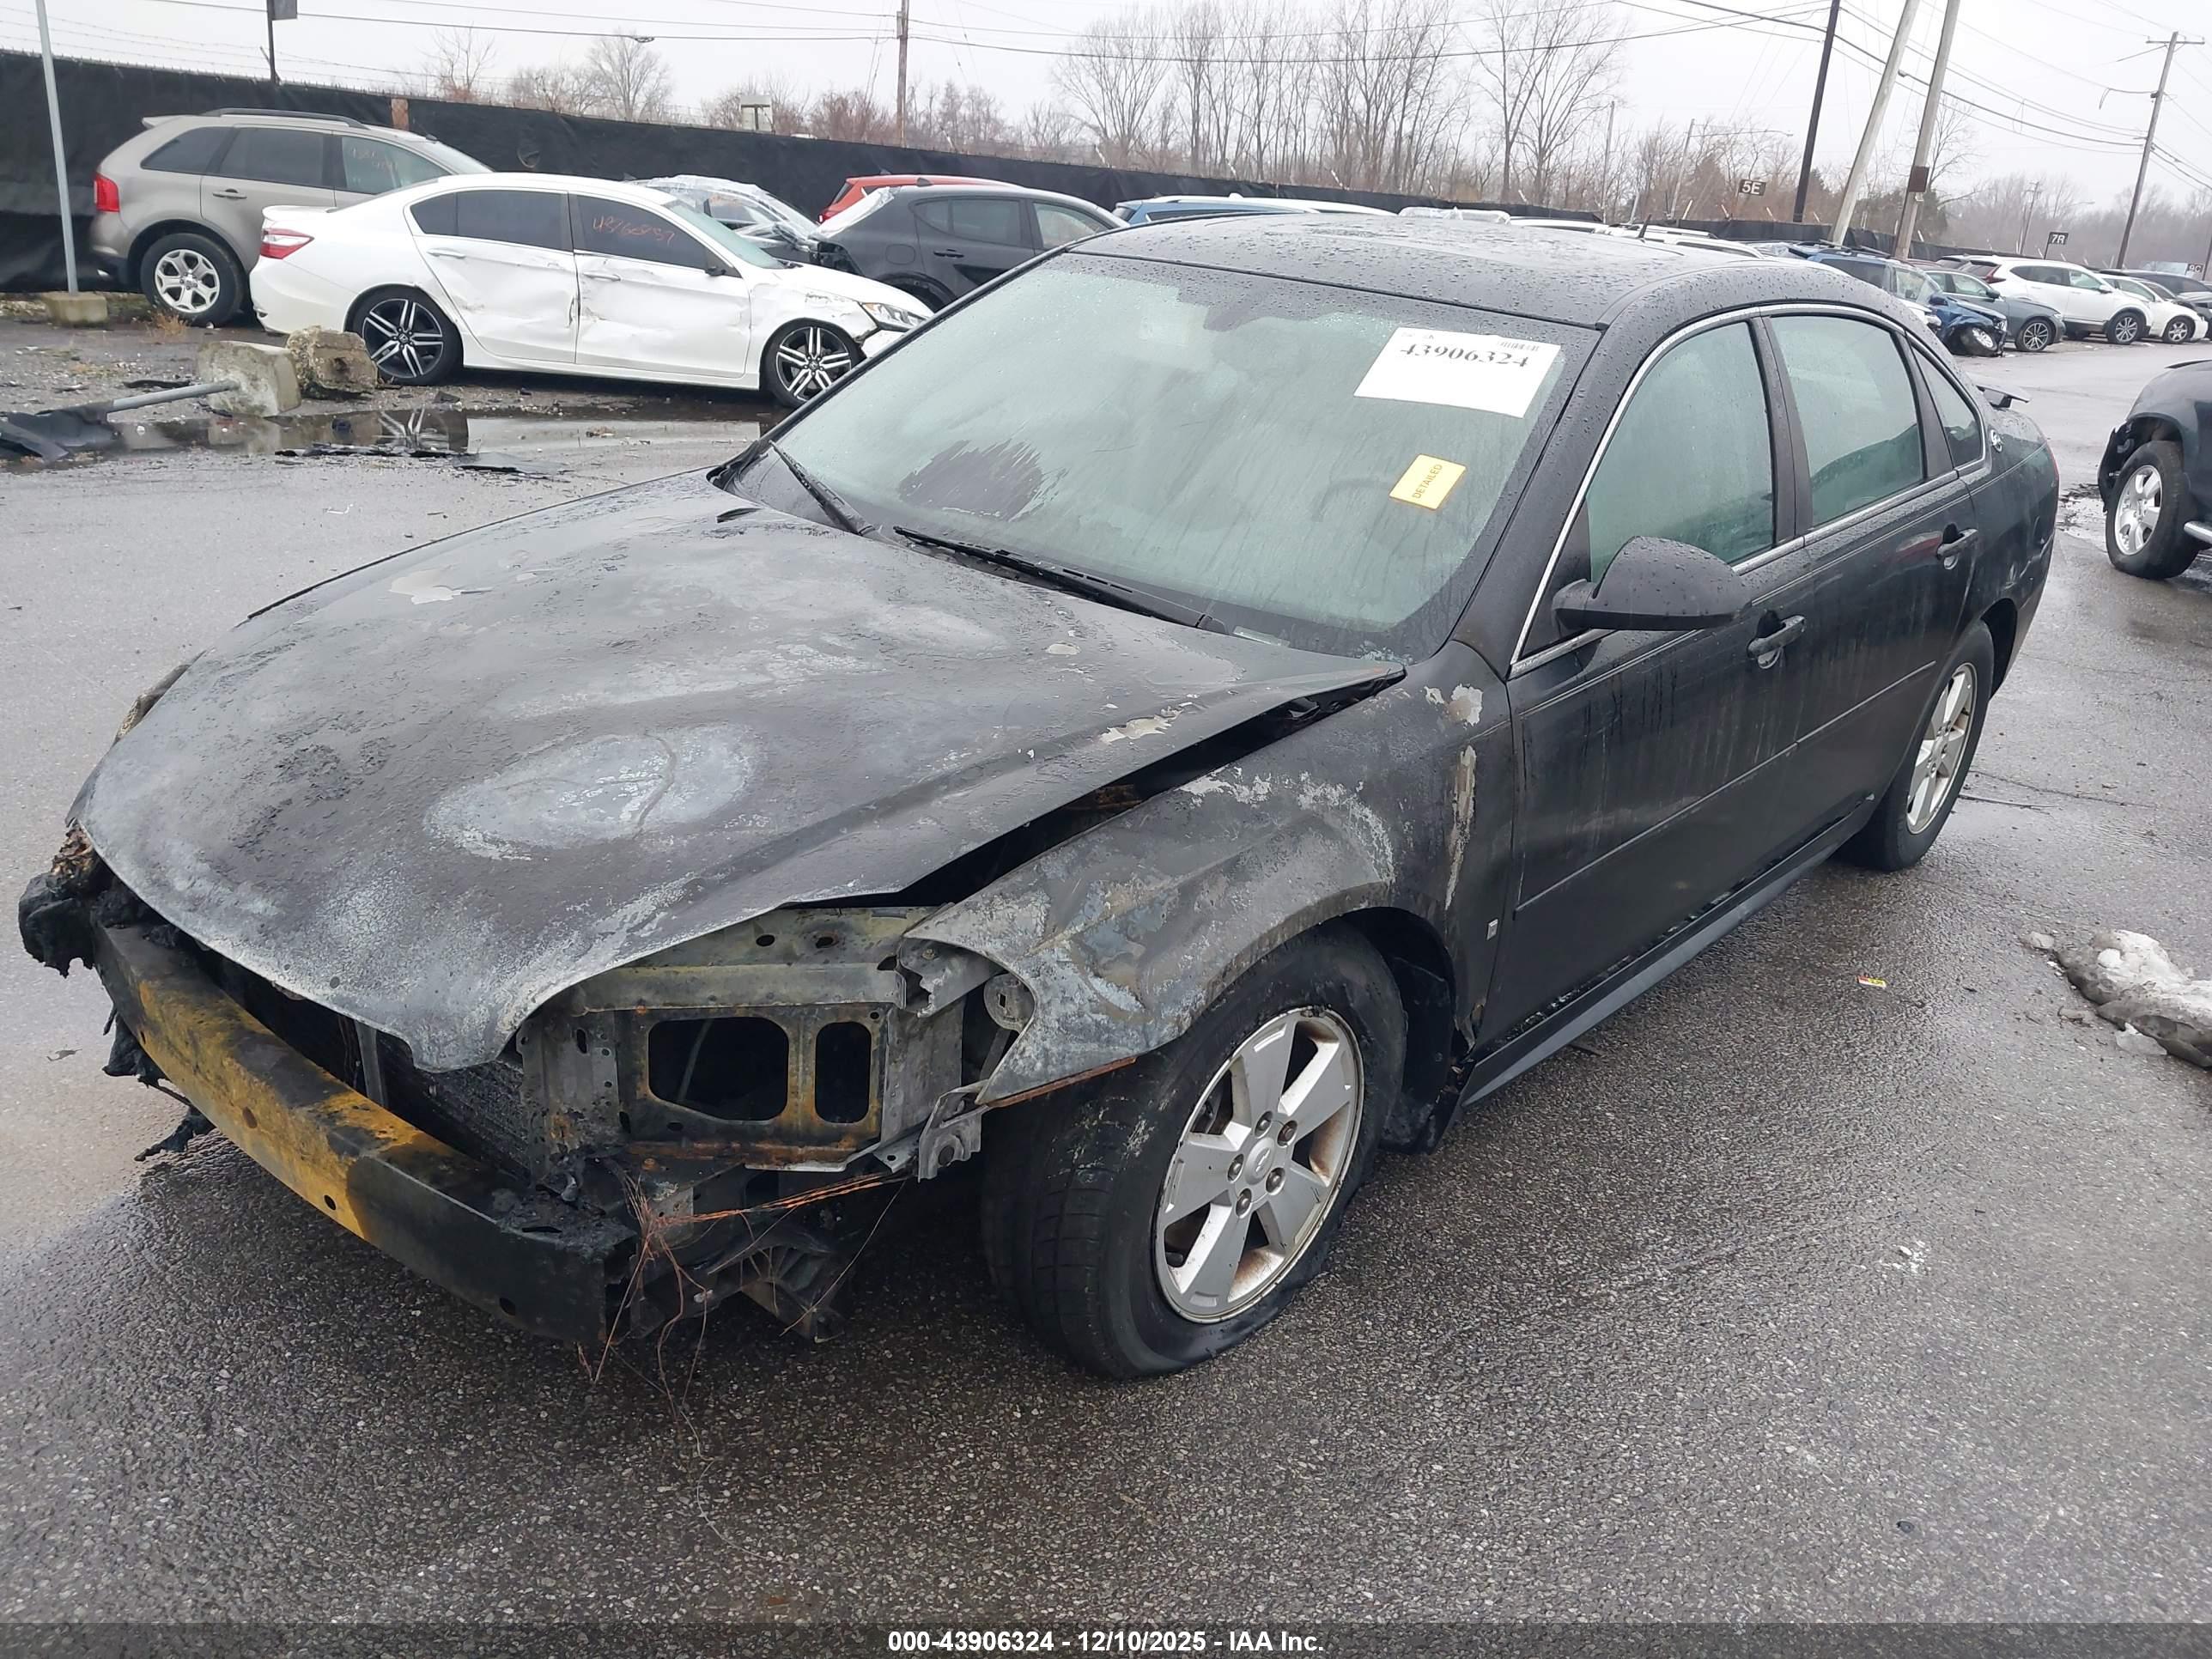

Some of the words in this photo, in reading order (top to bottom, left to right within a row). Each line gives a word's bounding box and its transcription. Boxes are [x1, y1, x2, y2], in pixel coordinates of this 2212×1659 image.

[1742, 180, 1762, 195] 5E
[1400, 343, 1528, 368] 43906324
[1412, 464, 1443, 499] DETAILED
